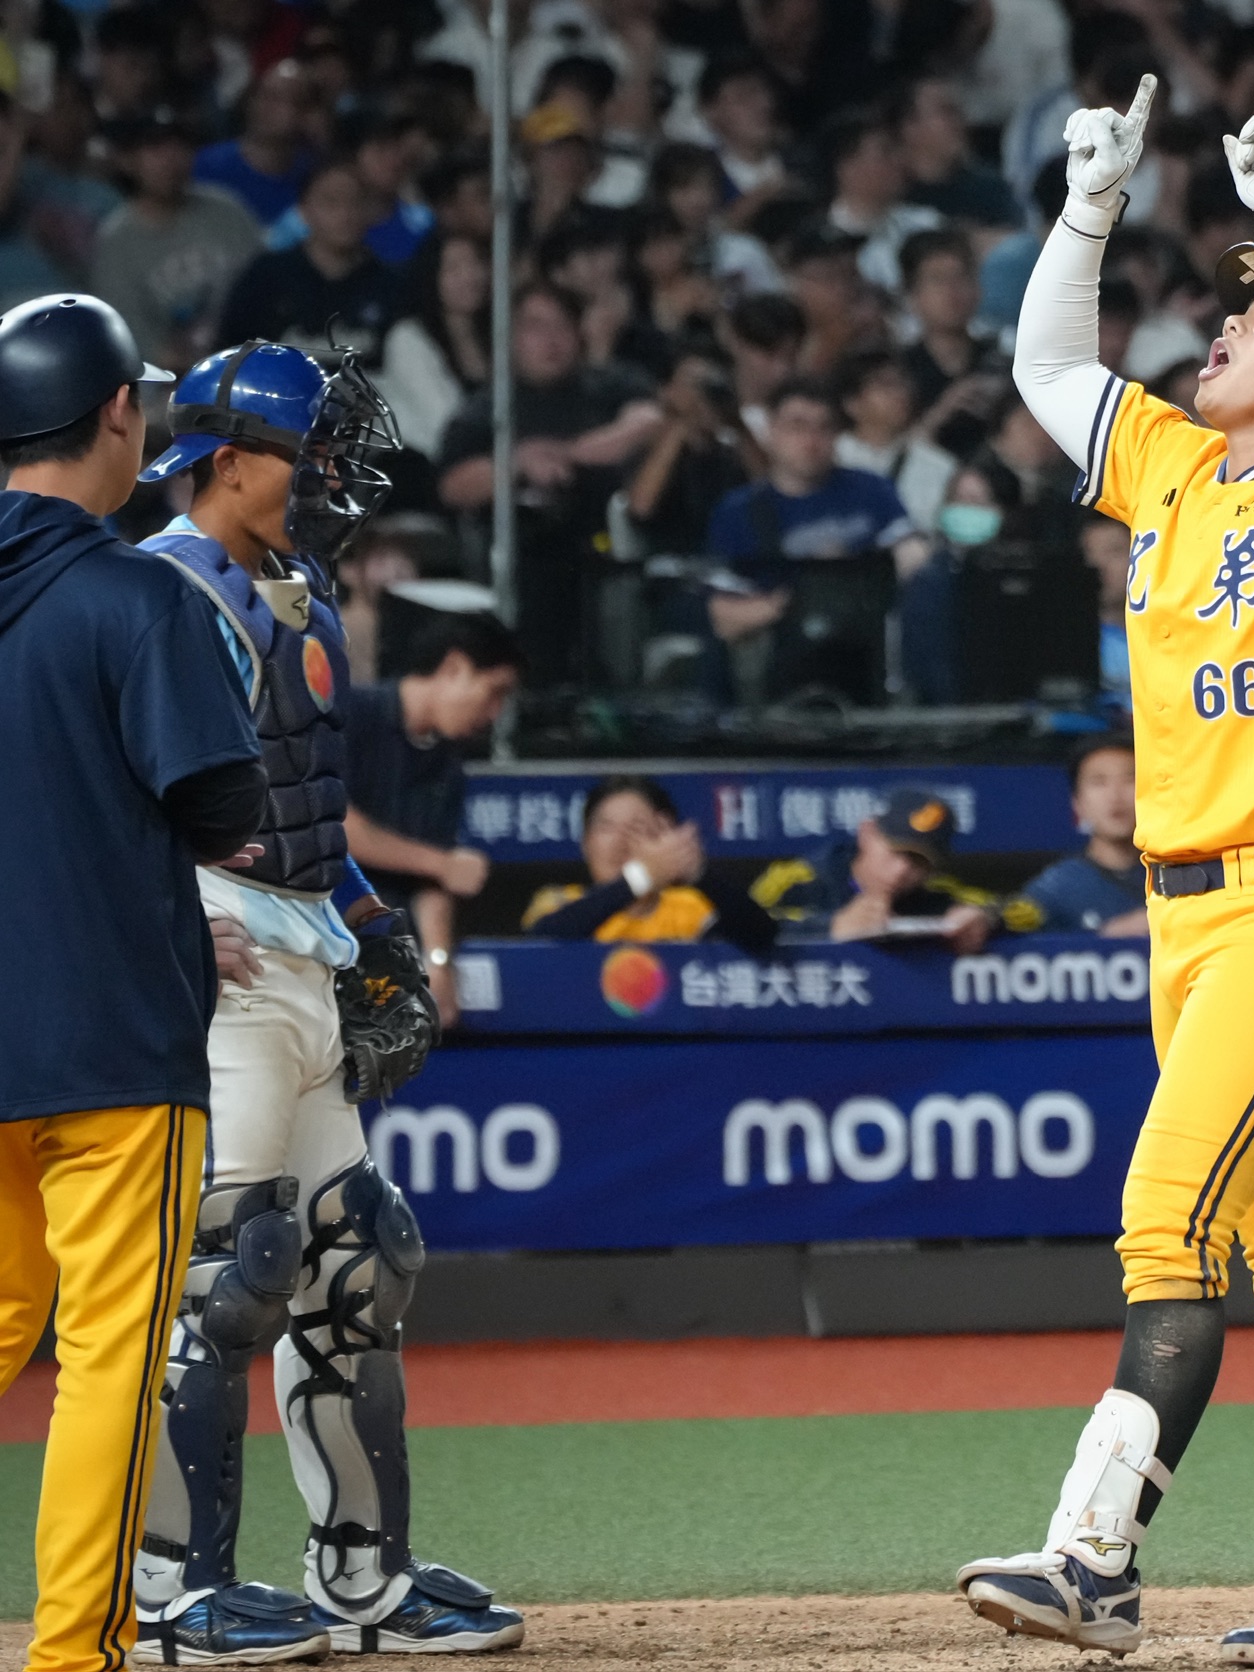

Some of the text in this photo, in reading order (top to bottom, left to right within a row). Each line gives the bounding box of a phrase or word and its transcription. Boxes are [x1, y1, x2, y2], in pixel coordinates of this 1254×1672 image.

[467, 791, 588, 843] 華投
[952, 951, 1150, 1005] momo
[368, 1101, 561, 1195] mo
[722, 1089, 1096, 1187] momo
